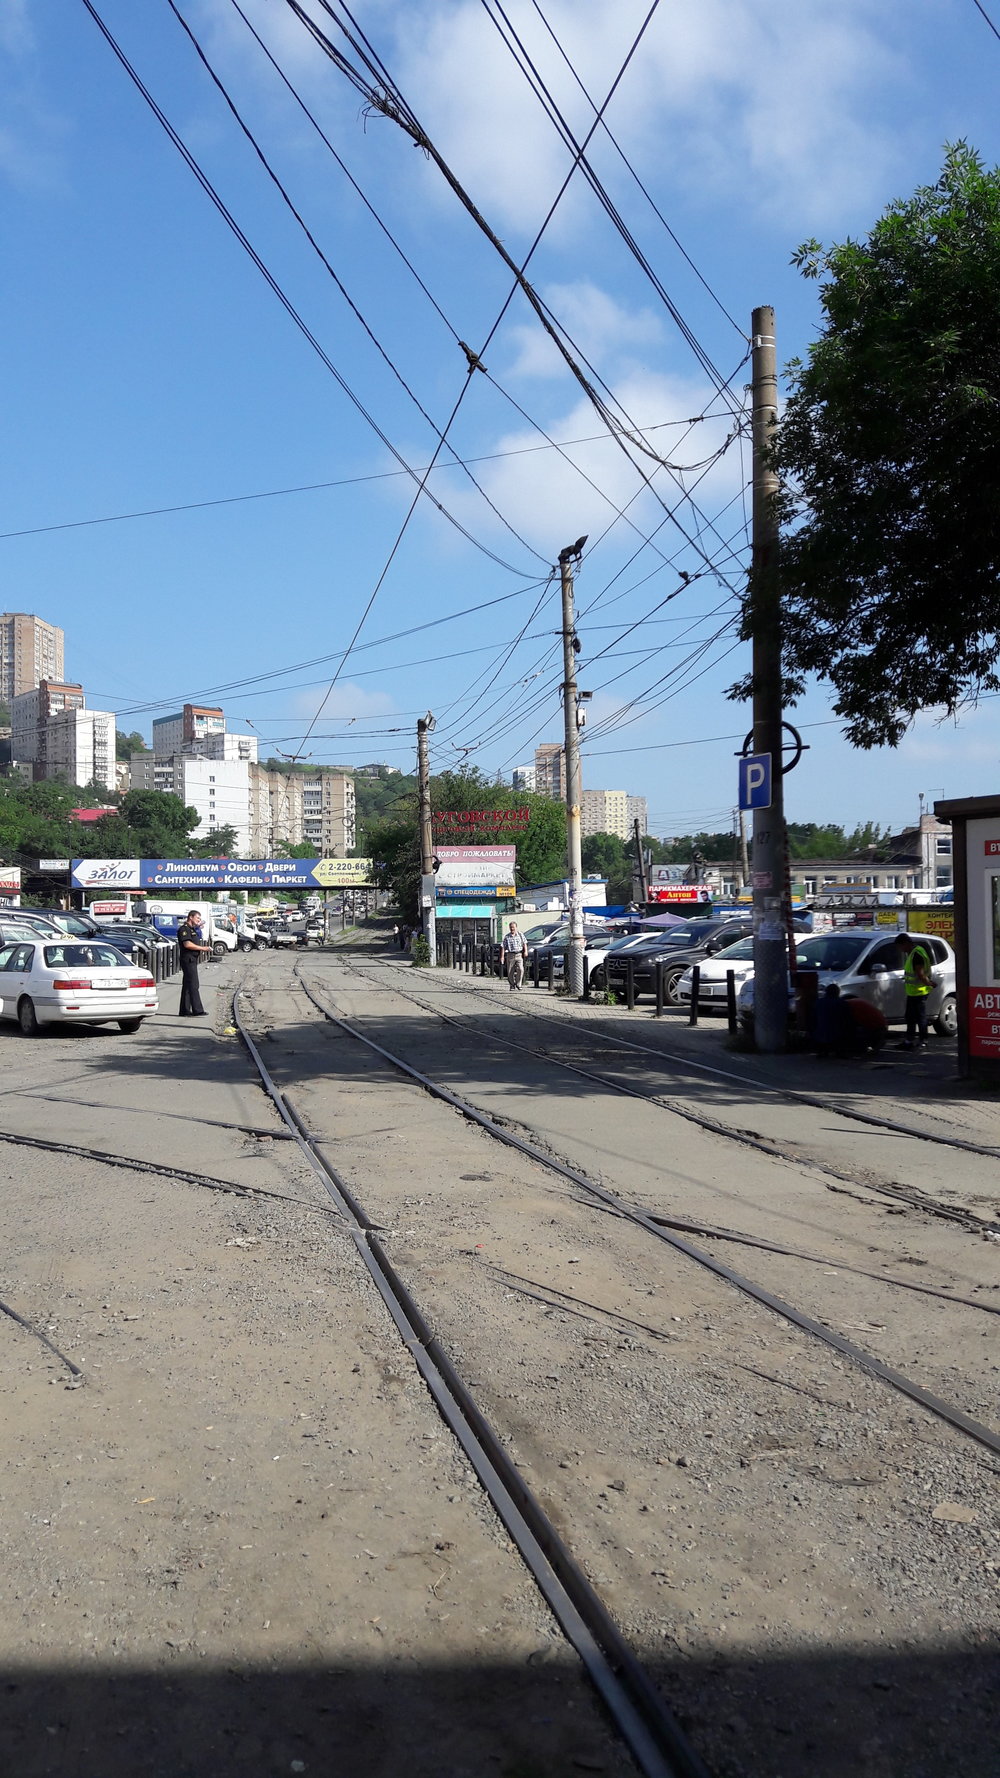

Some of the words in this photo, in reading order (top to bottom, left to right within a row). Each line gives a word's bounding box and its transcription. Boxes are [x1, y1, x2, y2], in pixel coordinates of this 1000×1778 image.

[747, 763, 765, 805] P
[165, 862, 219, 872] ЛИНОЛЕУМ
[227, 862, 257, 872] ОБОИ
[264, 862, 296, 873] ДВЕРИ
[88, 870, 136, 879] ЗАЛОГ
[154, 874, 216, 884] САНТЕХНИКА
[224, 874, 263, 884] КАФЕЛЬ
[271, 874, 307, 884] ПАРКЕТ
[974, 993, 1000, 1009] АВТ
